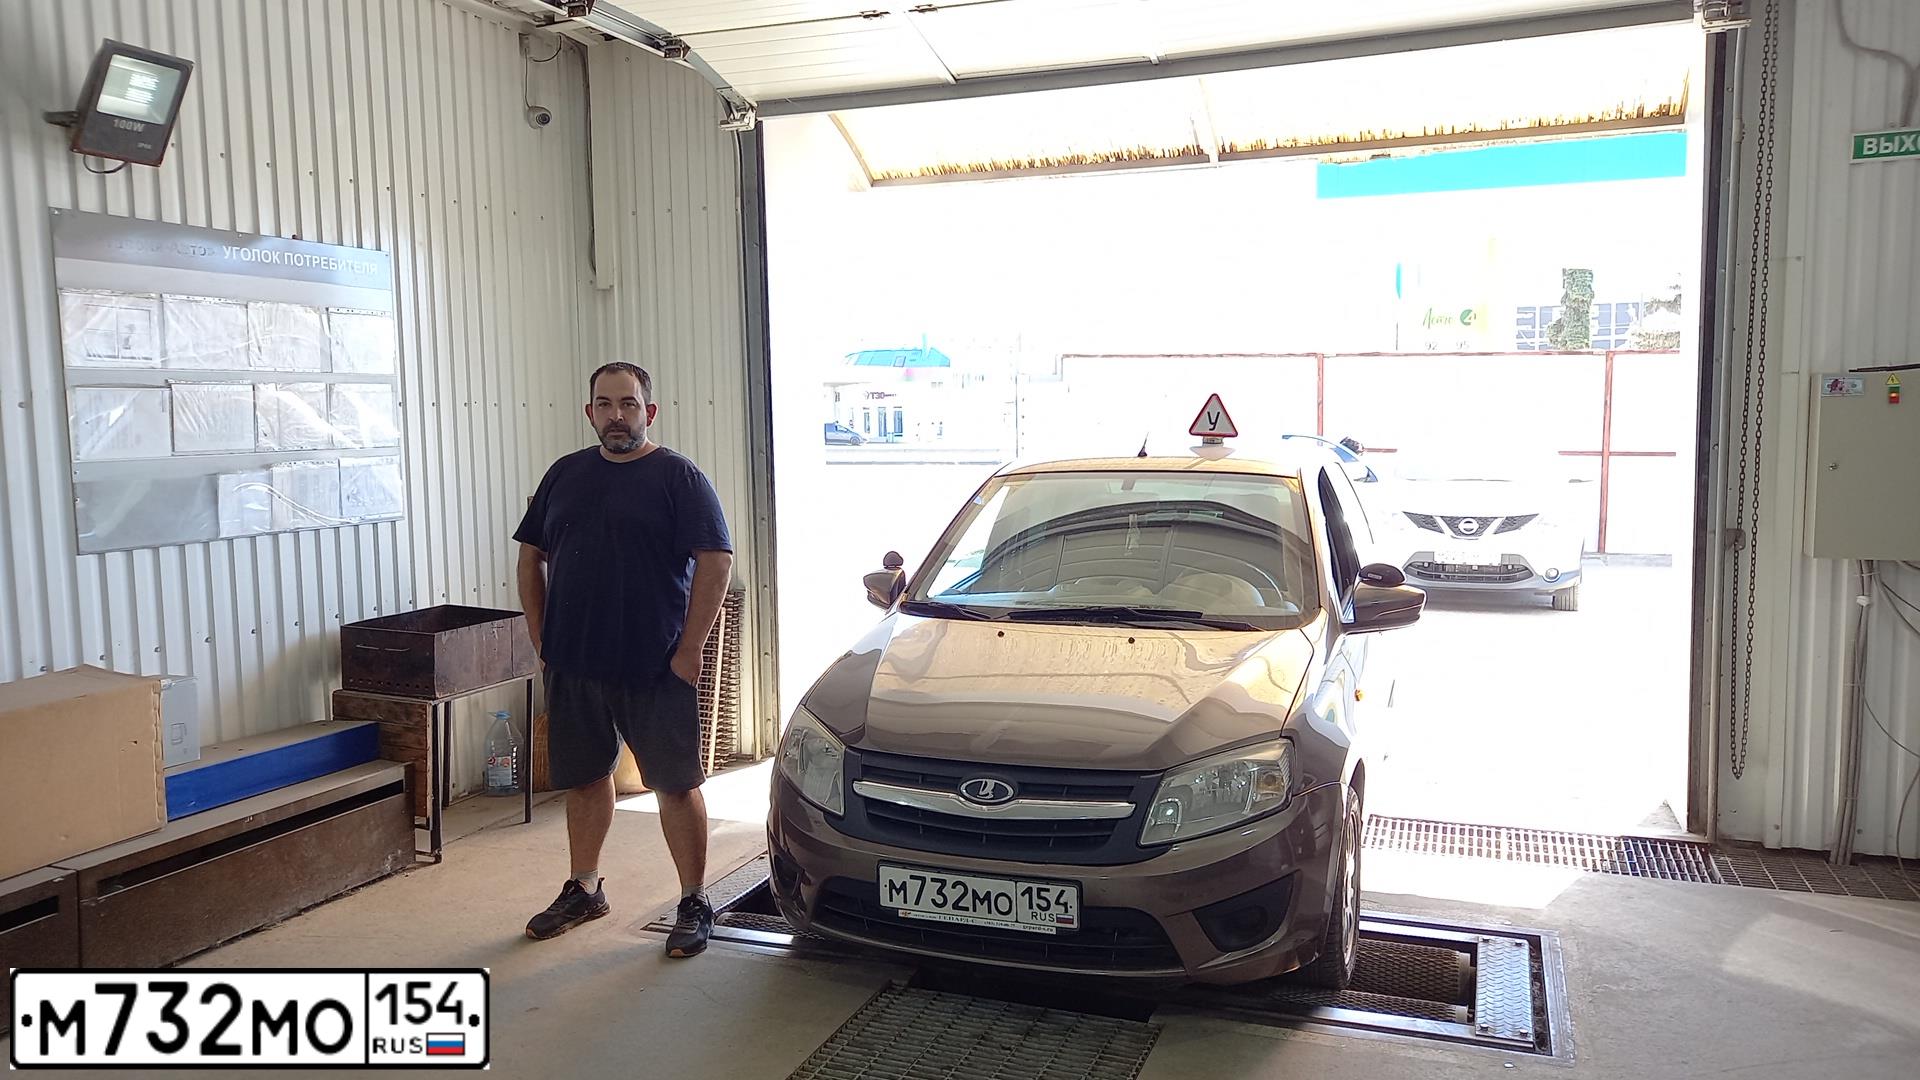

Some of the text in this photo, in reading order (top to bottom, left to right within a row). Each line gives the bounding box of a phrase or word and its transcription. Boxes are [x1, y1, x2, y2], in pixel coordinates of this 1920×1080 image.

[113, 119, 146, 133] 100W
[223, 246, 281, 264] УГОЛОК
[284, 252, 378, 274] ПОТРЕБИТЕЛЯ
[888, 875, 1070, 916] М732МО 154
[1031, 911, 1055, 923] RUS
